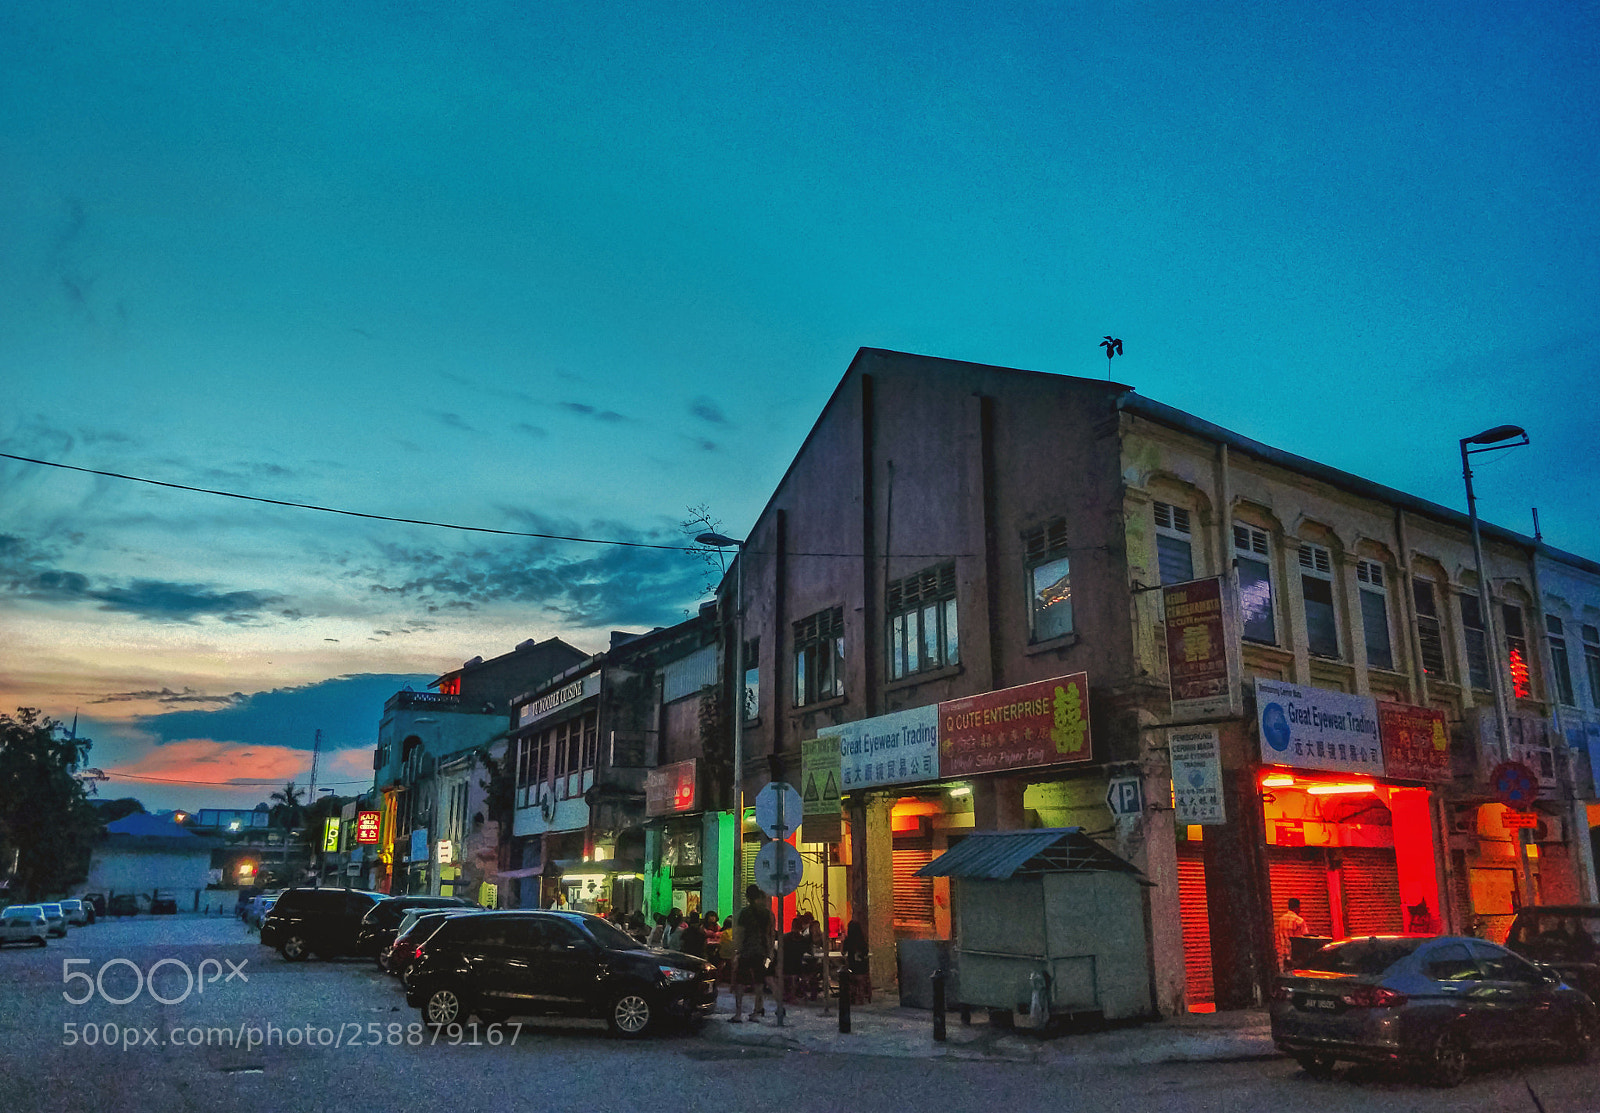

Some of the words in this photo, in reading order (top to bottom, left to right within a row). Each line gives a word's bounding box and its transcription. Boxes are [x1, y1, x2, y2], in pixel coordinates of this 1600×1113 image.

[946, 716, 954, 732] Q
[955, 711, 982, 730] CUTE
[983, 697, 1050, 725] ENTERPRISE
[1288, 702, 1312, 726] Great
[1312, 706, 1346, 733] Eyewear
[1346, 711, 1377, 740] Trading
[840, 738, 862, 757] Great
[864, 734, 900, 757] Eyewear
[901, 723, 937, 747] Trading
[1123, 785, 1134, 810] P
